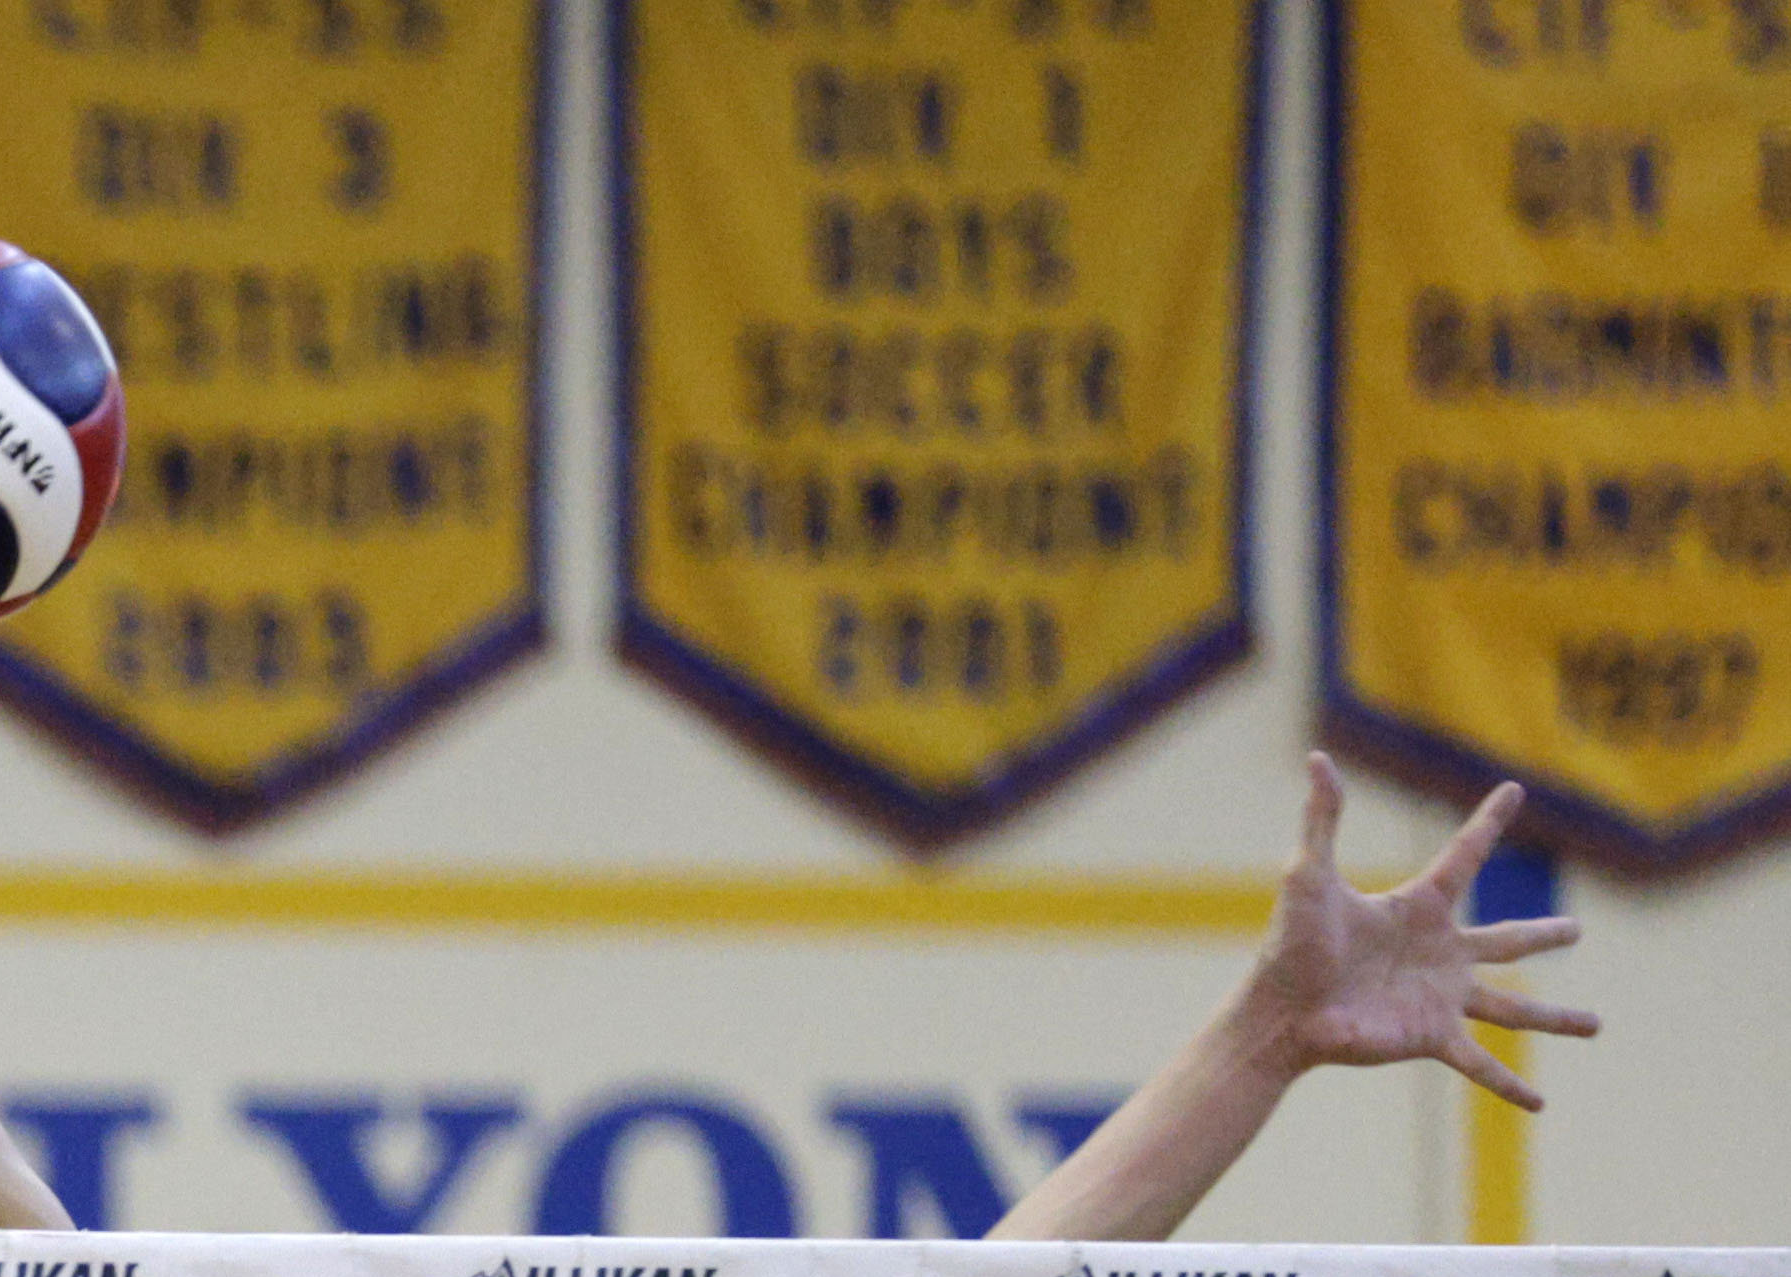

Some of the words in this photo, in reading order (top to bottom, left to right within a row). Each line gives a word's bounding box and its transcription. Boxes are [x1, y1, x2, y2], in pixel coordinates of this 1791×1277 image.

[108, 257, 503, 373] STLING
[738, 320, 1125, 437] SOCCER
[110, 414, 500, 519] MPIONS
